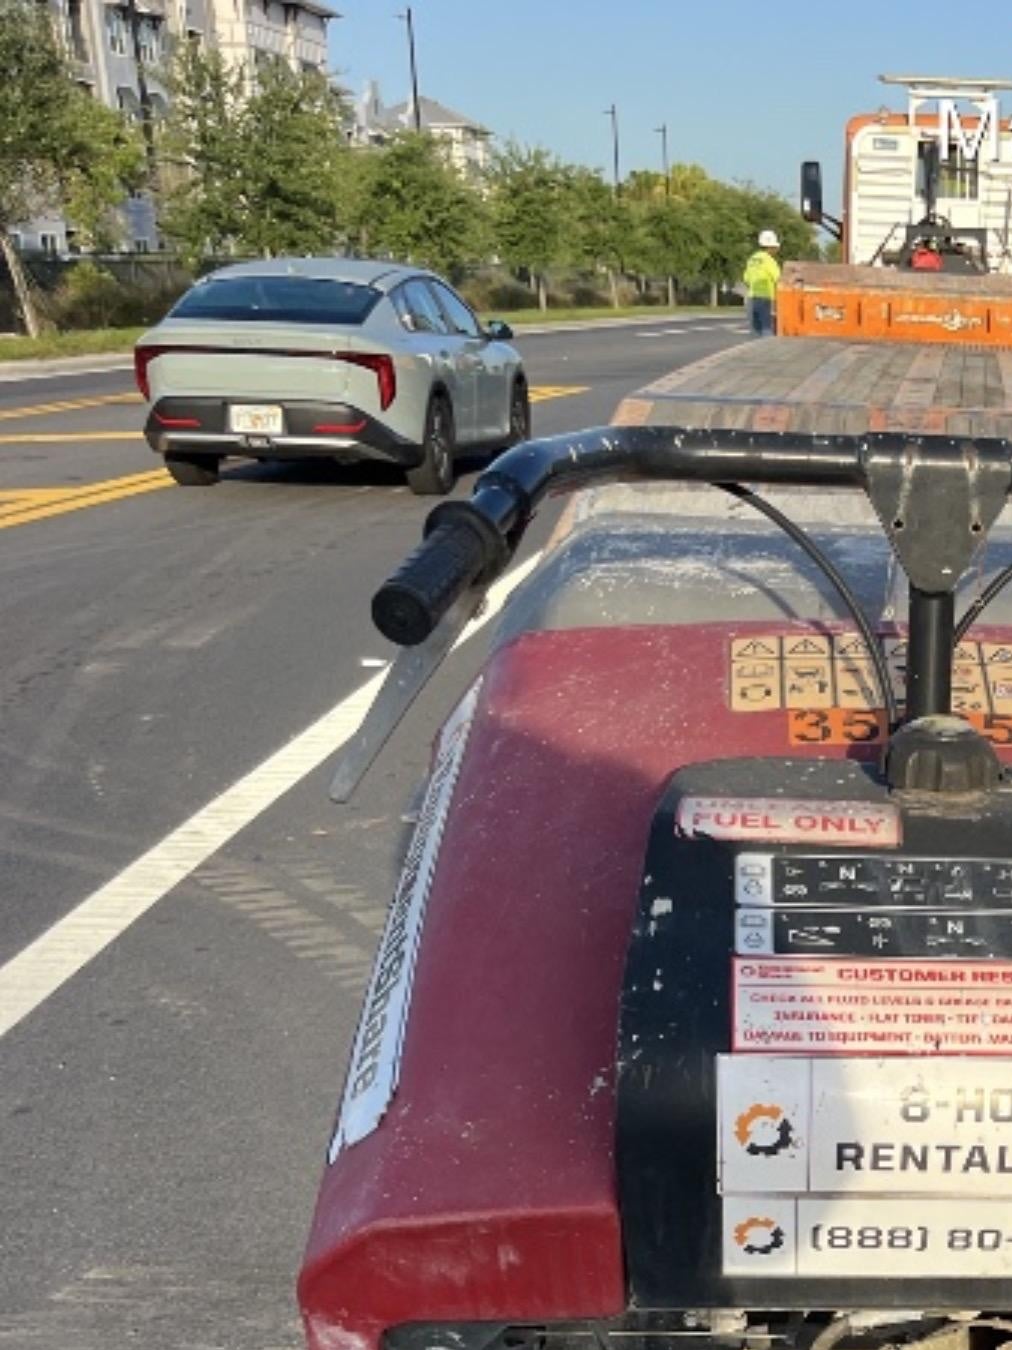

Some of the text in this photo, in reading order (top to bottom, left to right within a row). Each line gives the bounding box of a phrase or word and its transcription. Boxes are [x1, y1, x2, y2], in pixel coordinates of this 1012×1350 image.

[692, 812, 884, 834] FUEL ONLY
[837, 967, 966, 983] CUSTOMER
[810, 1222, 930, 1252] (888)
